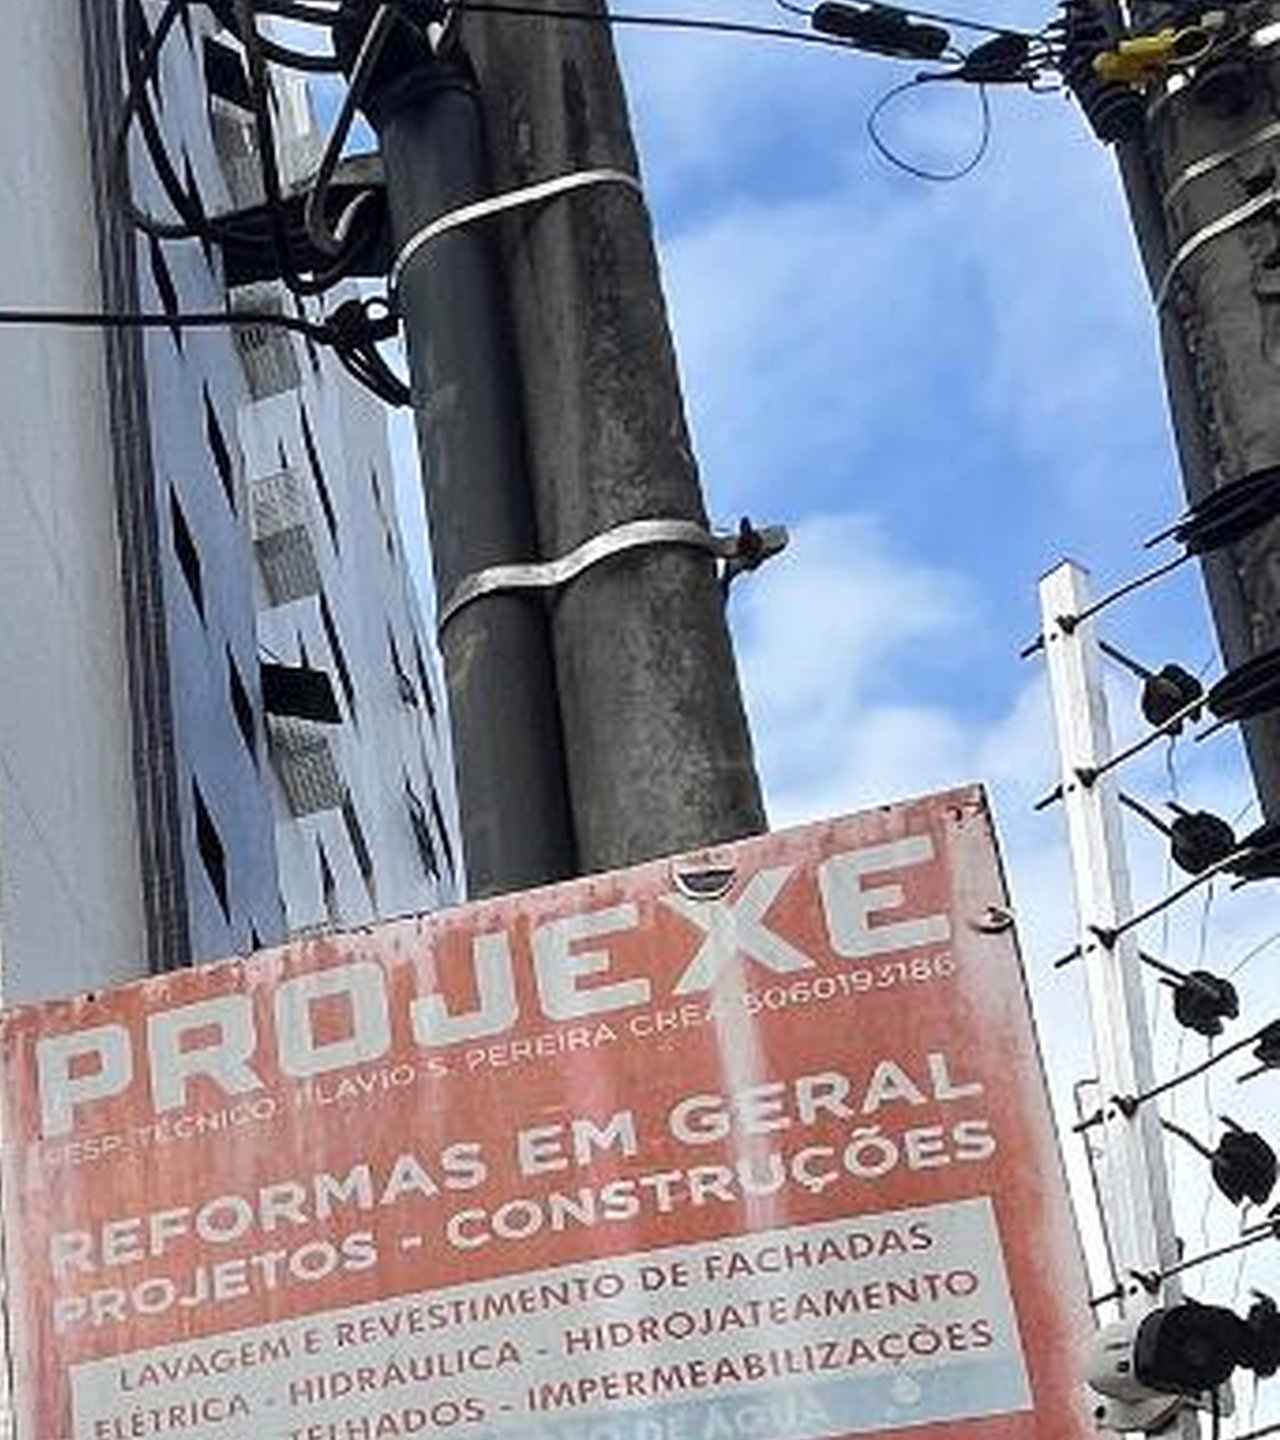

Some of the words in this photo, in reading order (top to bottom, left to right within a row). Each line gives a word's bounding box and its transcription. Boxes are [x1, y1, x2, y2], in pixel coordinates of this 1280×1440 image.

[36, 834, 951, 1138] PROJEXE
[297, 1065, 416, 1105] LAVIO
[465, 1022, 617, 1071] PEREIRA
[49, 1141, 488, 1274] REFORMAS
[517, 1110, 639, 1176] EM
[670, 1052, 985, 1146] GERAL
[52, 1231, 378, 1333] PROJETOS
[446, 1119, 997, 1249] CONSTRUÇÕES
[120, 1336, 290, 1391] LAVAGEM
[303, 1332, 321, 1355] E
[338, 1273, 624, 1347] REVESTIMENTO
[640, 1264, 688, 1291] DE
[705, 1222, 933, 1281] FACHADAS
[526, 1319, 995, 1413] IMPERMEABILIZAÇÕES
[564, 1269, 979, 1356] HIDROJATEAMENTO
